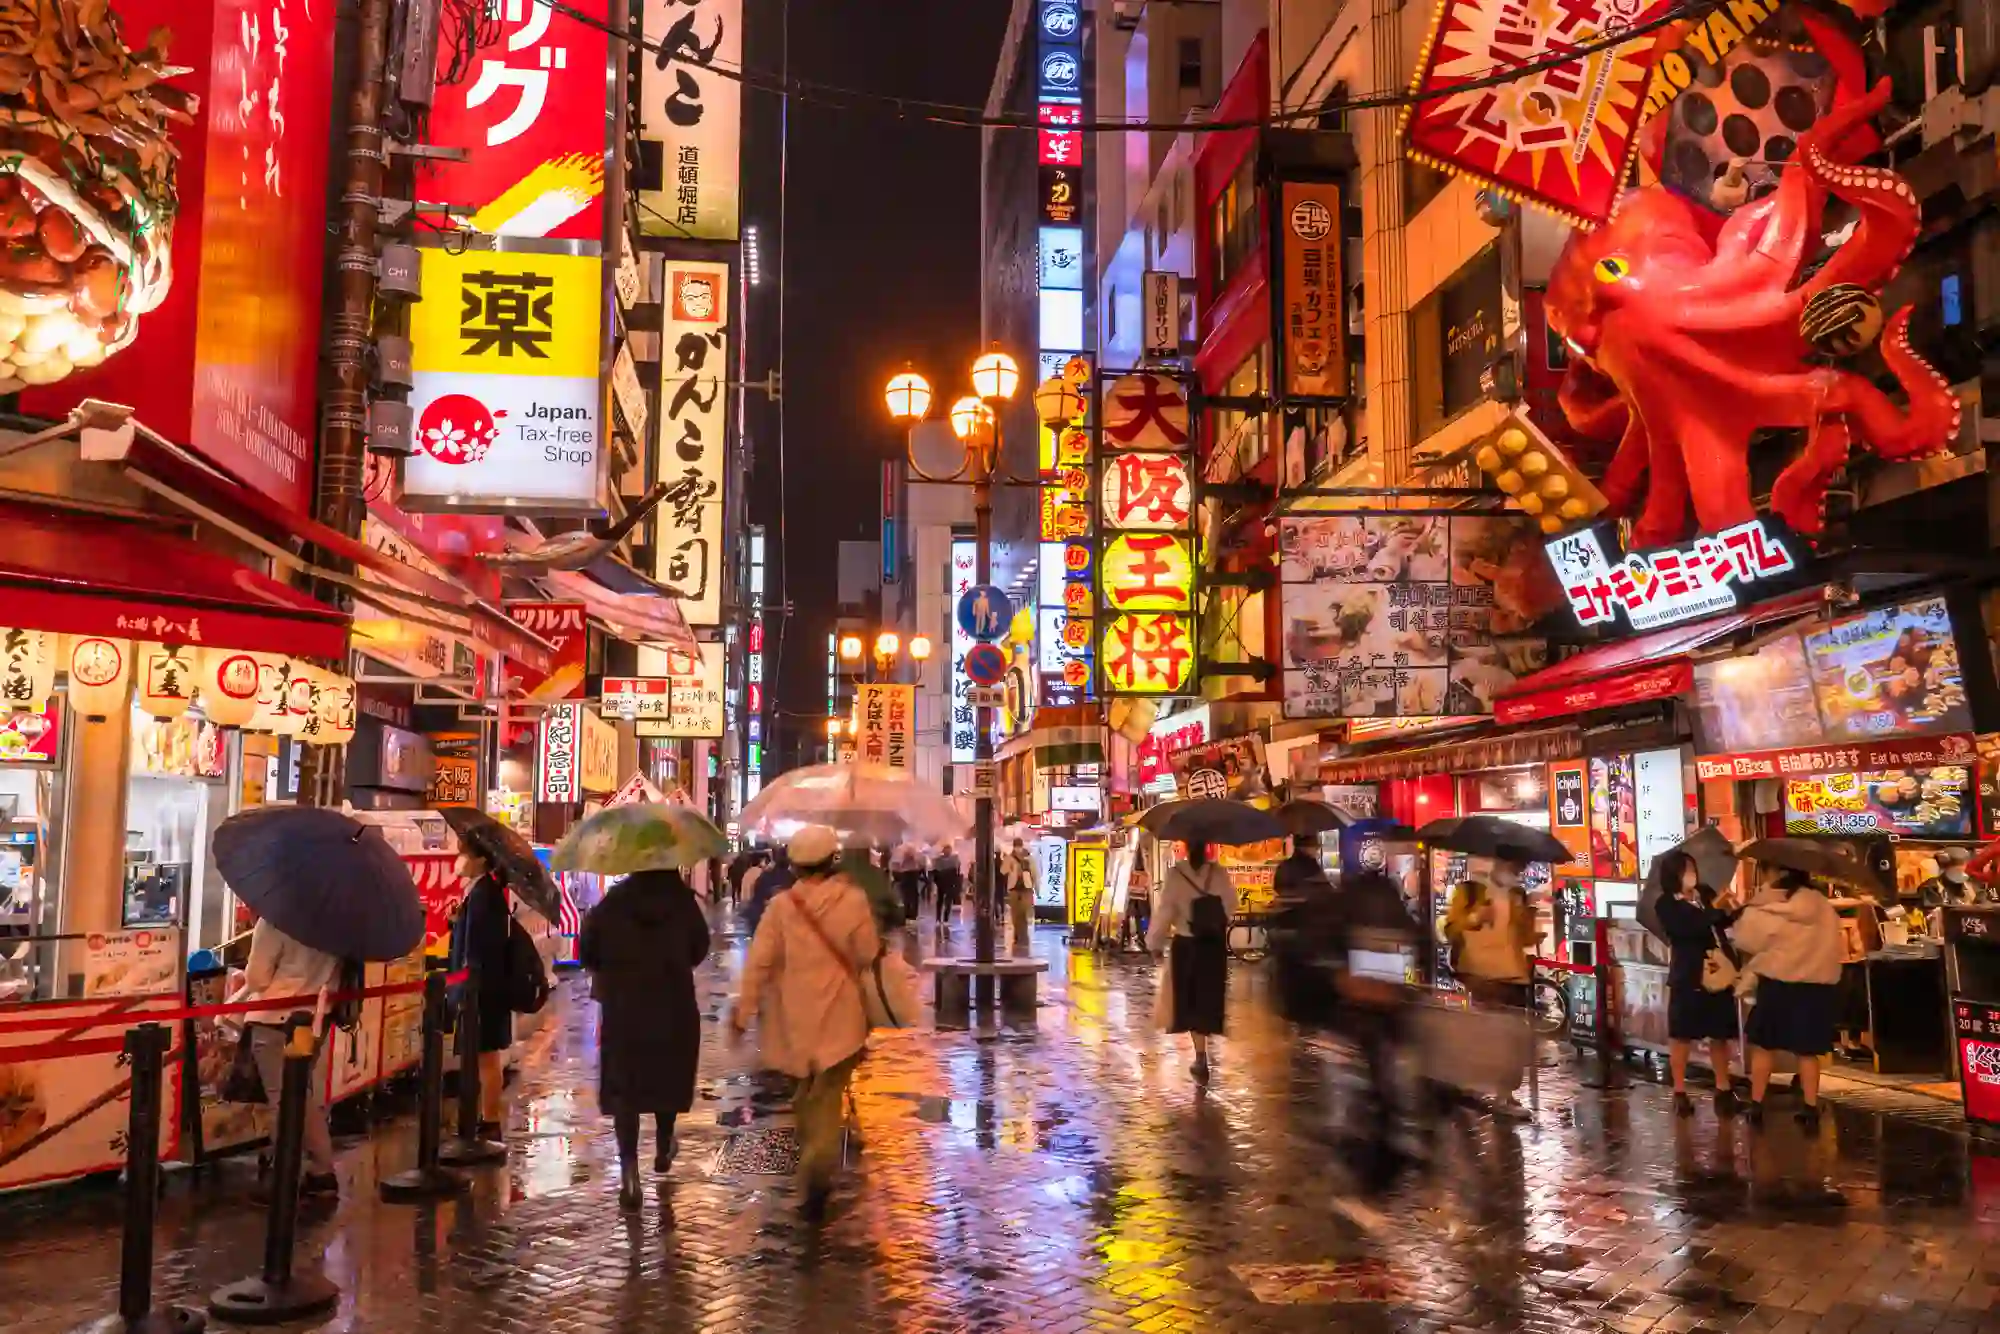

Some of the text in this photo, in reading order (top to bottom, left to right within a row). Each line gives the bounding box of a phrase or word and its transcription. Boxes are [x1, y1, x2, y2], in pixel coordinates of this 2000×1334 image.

[655, 0, 724, 126] んこ
[677, 146, 700, 225] 道頓堀店
[388, 267, 408, 277] CH1
[460, 271, 553, 358] 薬
[525, 402, 592, 422] Japan.
[516, 424, 592, 444] Tax-free
[544, 445, 592, 466] Shop
[1106, 376, 1191, 691] 大阪王将
[1569, 527, 1790, 621] コナモンミュージアム
[513, 609, 583, 630] ツルハ
[636, 699, 665, 713] 和食
[1870, 753, 1888, 764] Eat
[1889, 752, 1899, 764] in
[435, 762, 472, 785] 大阪
[1824, 813, 1877, 828] ¥1,350
